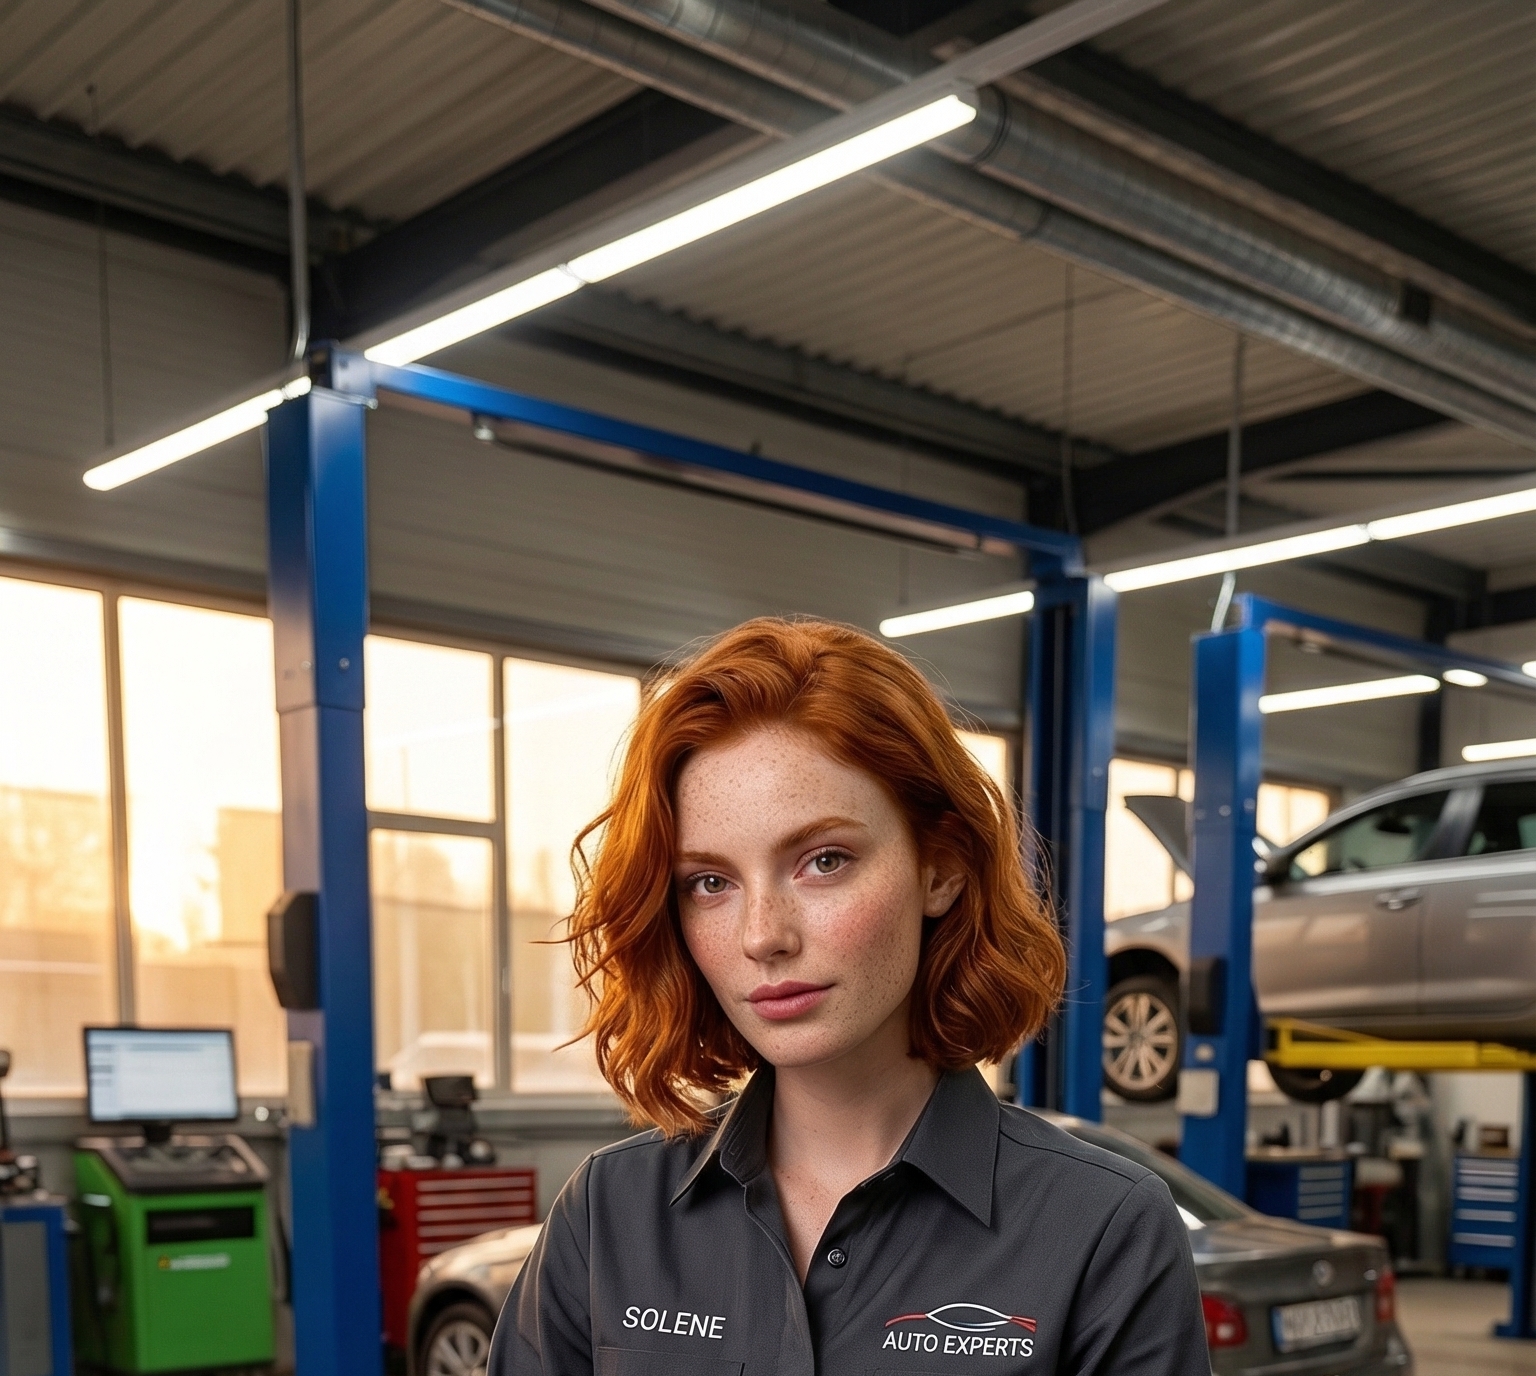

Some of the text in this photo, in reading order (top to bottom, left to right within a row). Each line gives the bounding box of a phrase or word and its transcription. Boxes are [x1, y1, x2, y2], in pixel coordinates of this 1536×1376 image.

[622, 1306, 727, 1340] SOLENE
[881, 1330, 1035, 1357] AUTO EXPERTS
